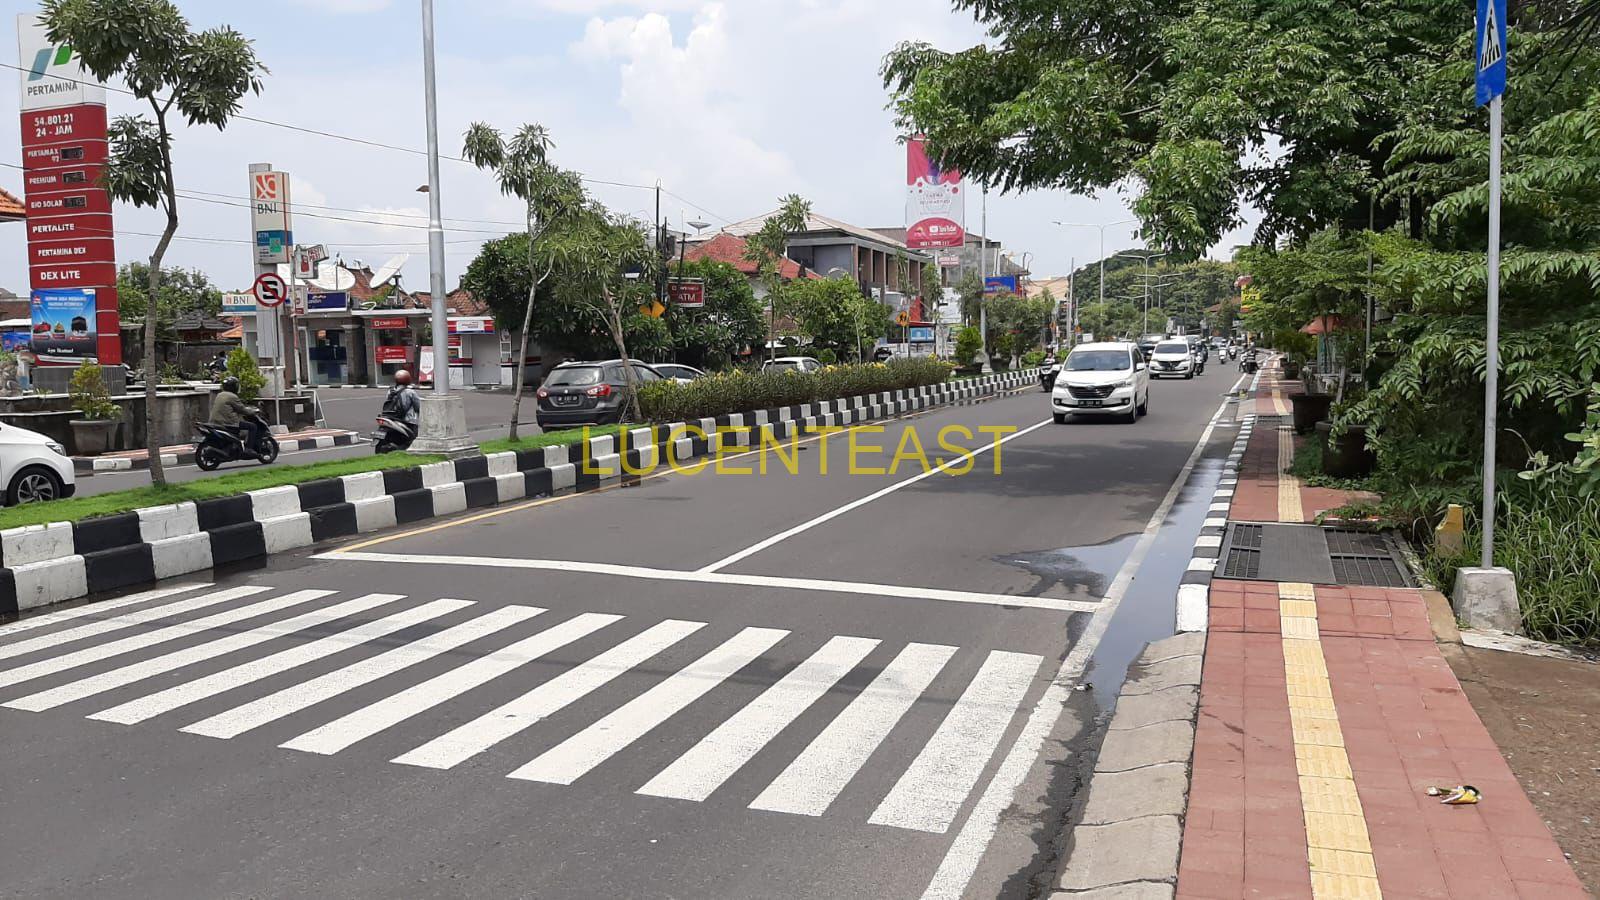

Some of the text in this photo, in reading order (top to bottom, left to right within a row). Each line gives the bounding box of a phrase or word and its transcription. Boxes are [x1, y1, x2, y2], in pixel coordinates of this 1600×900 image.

[27, 81, 78, 96] PERTAMINA
[34, 113, 73, 127] 54.801.21
[35, 127, 46, 138] 24
[54, 124, 73, 136] JAM
[257, 203, 277, 214] BNI
[32, 223, 75, 233] PERTALITE
[38, 246, 87, 256] PERTAMINA DEX
[40, 270, 81, 280] DEX LITE
[233, 296, 249, 305] BNI
[678, 293, 696, 302] ATM
